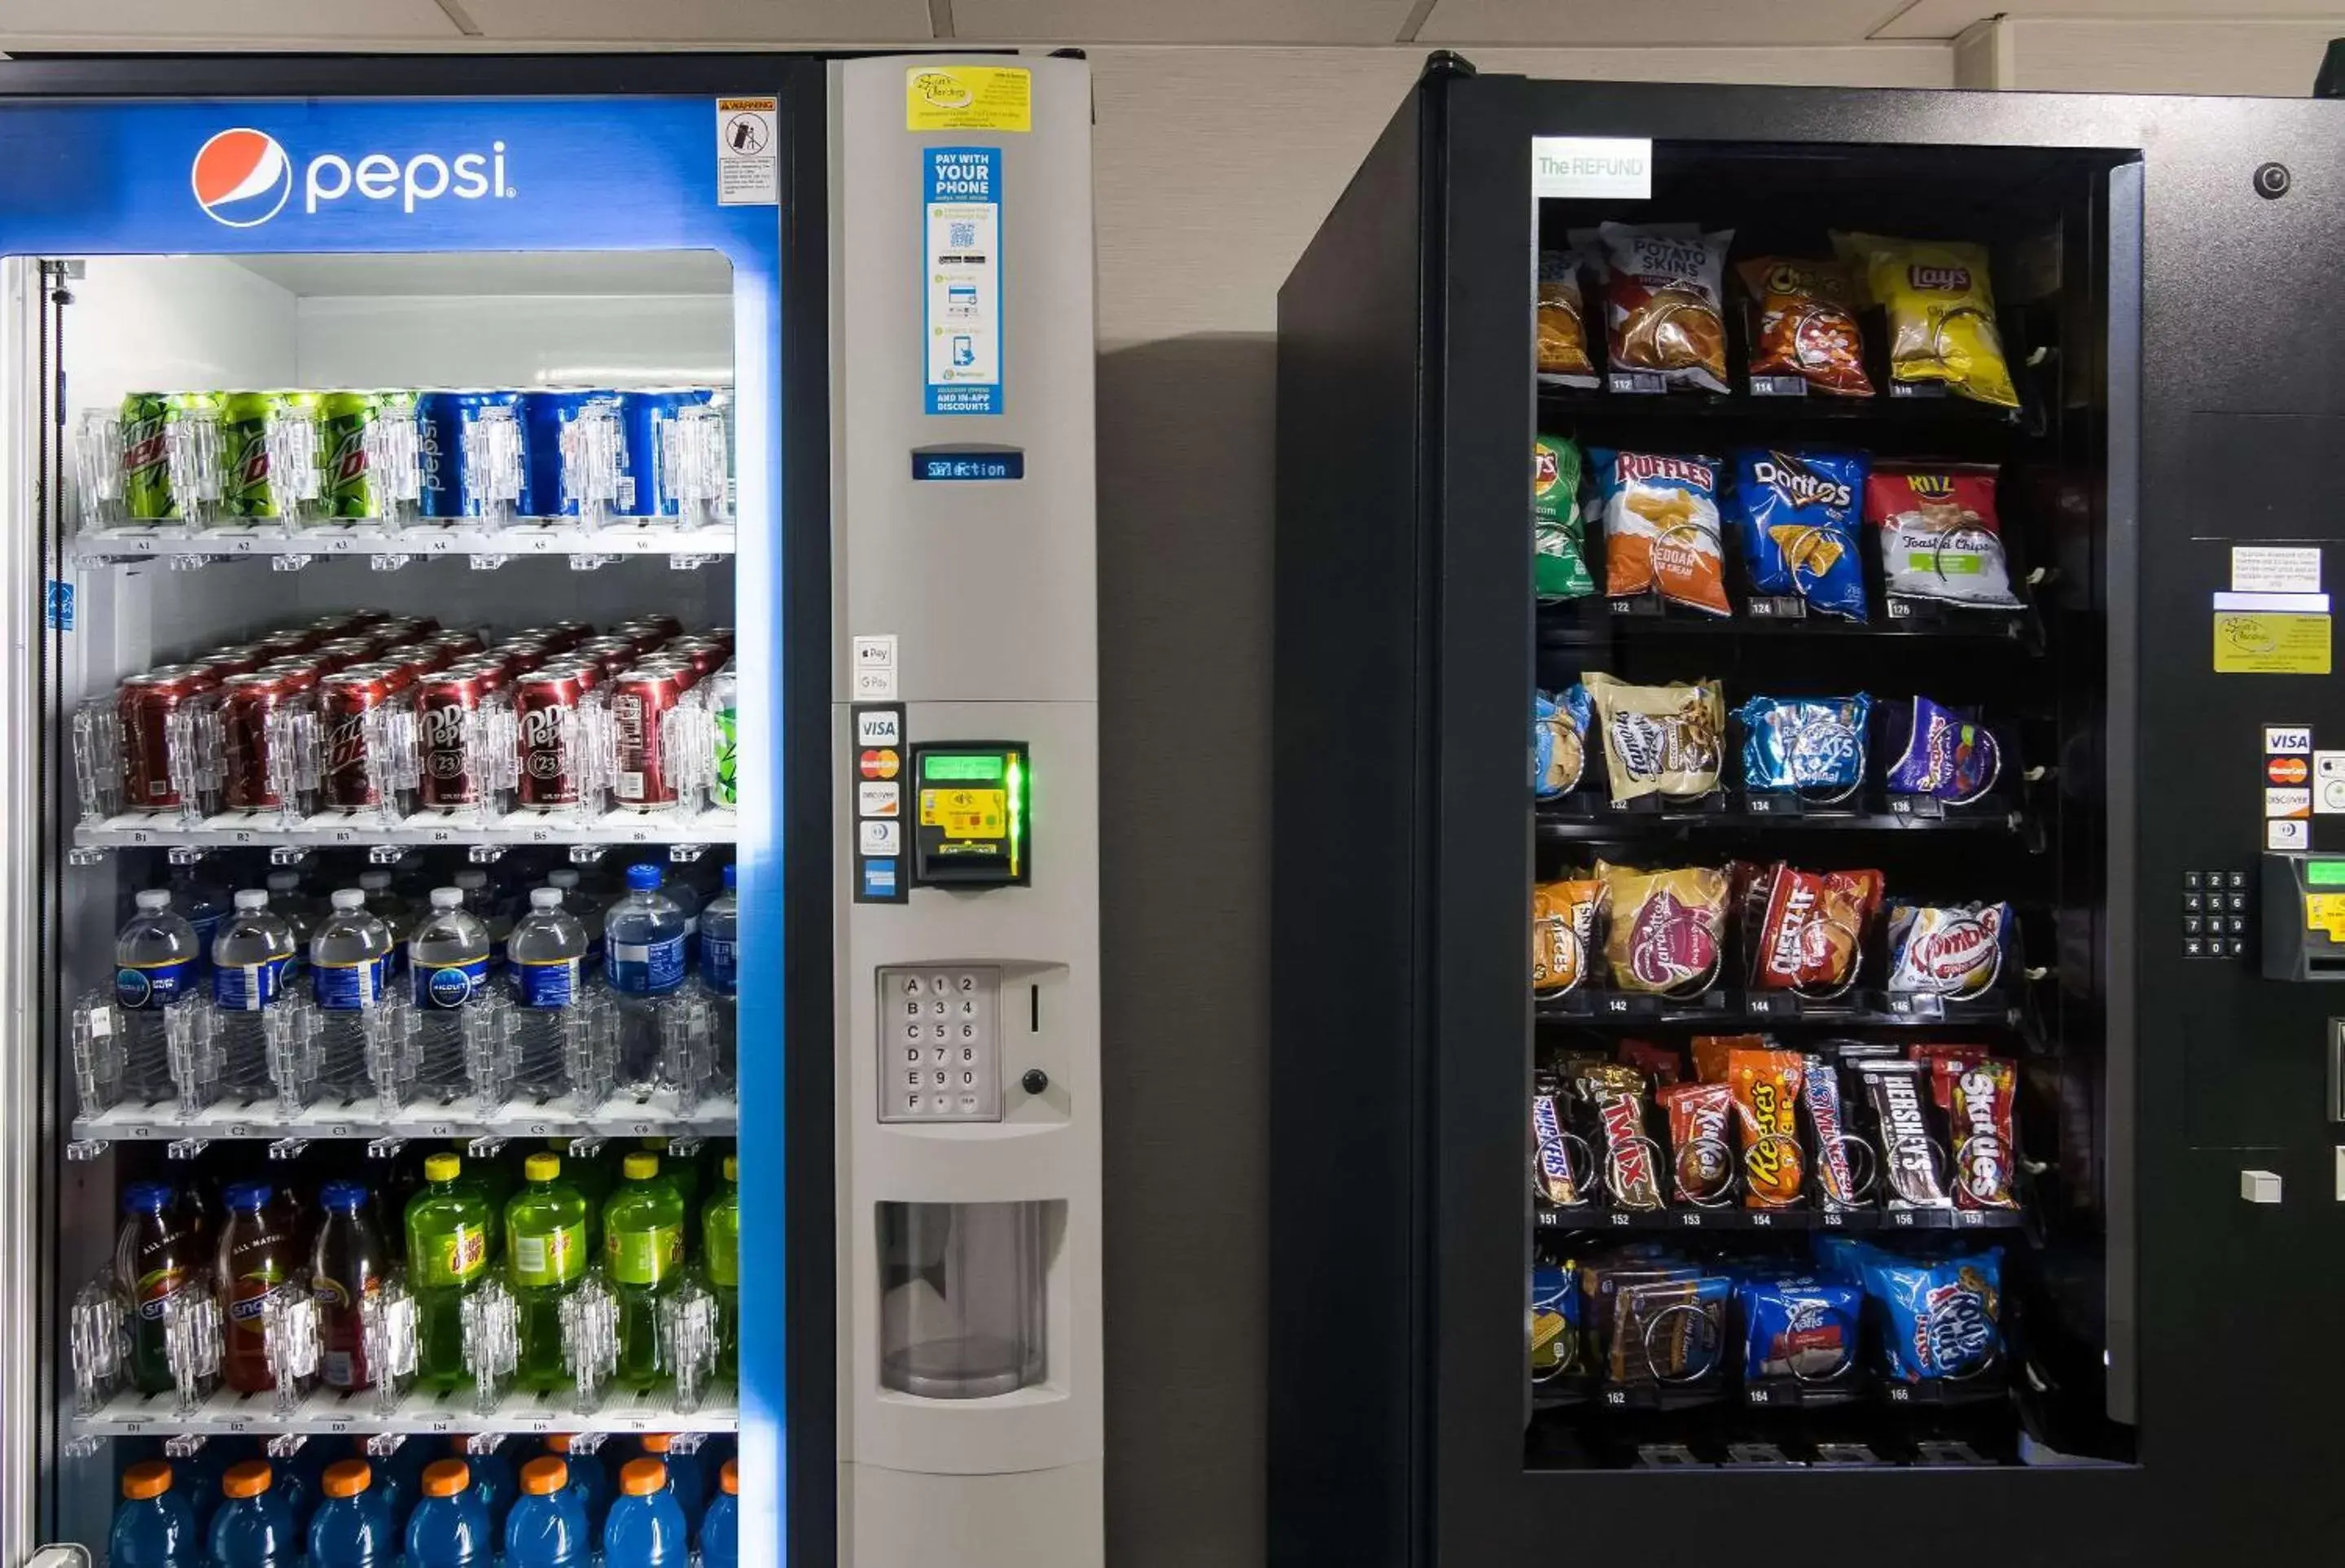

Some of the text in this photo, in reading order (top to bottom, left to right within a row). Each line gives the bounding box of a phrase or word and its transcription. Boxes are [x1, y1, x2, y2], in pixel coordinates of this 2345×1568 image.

[936, 154, 988, 164] PAY WITH
[1539, 157, 1644, 176] The REFUND
[306, 142, 503, 213] pepsi
[936, 165, 988, 180] YOUR
[936, 181, 988, 195] PHONE
[1633, 239, 1707, 265] POTATO
[1643, 256, 1699, 279] SKINS
[937, 394, 990, 403] AND IN-APP
[937, 402, 990, 411] DISCOUNTS
[423, 419, 445, 492] pepsi
[1615, 450, 1712, 492] RUFFLES
[1754, 462, 1851, 506] Doritos
[1906, 475, 1954, 493] RITZ
[138, 541, 150, 550] A1
[237, 541, 250, 550] A2
[335, 541, 348, 550] A3
[433, 541, 446, 550] A4
[534, 541, 546, 550] A5
[1955, 537, 1992, 553] Chips
[1612, 602, 1628, 611] 122
[1752, 604, 1769, 613] 124
[870, 648, 887, 660] Pay
[871, 677, 888, 690] Pay
[422, 709, 459, 747] Pep
[519, 709, 561, 747] Pep
[864, 721, 896, 735] VISA
[1615, 711, 1648, 782] Famous
[2271, 735, 2308, 748] VISA
[438, 756, 455, 770] 23
[539, 756, 556, 770] 23
[1752, 801, 1769, 811] 134
[2191, 877, 2241, 886] 1 2 3
[2190, 899, 2241, 908] 4 5 6
[2190, 922, 2241, 931] 7 8 9
[2212, 944, 2220, 953] 0
[908, 979, 971, 991] A 1 2
[908, 1001, 971, 1014] B 3 4
[1610, 1001, 1627, 1011] 142
[1751, 1001, 1769, 1012] 144
[908, 1025, 971, 1038] C 5 6
[908, 1049, 971, 1061] D 7 8
[910, 1071, 971, 1084] E 9 0
[910, 1095, 918, 1107] F
[1884, 1075, 1932, 1172] HERSHEY'S
[135, 1127, 148, 1137] C1
[231, 1127, 245, 1137] C2
[332, 1127, 347, 1136] C3
[432, 1125, 446, 1135] C4
[531, 1125, 545, 1134] C5
[634, 1125, 648, 1134] C6
[1748, 1080, 1778, 1186] Reese's
[1535, 1098, 1569, 1178] SNICKERS
[1541, 1215, 1557, 1224] 151
[1612, 1215, 1629, 1224] 152
[1683, 1215, 1700, 1224] 153
[1753, 1215, 1770, 1225] 154
[1825, 1215, 1842, 1224] 155
[1895, 1214, 1913, 1224] 156
[1966, 1214, 1983, 1224] 157
[142, 1242, 160, 1255] ALL
